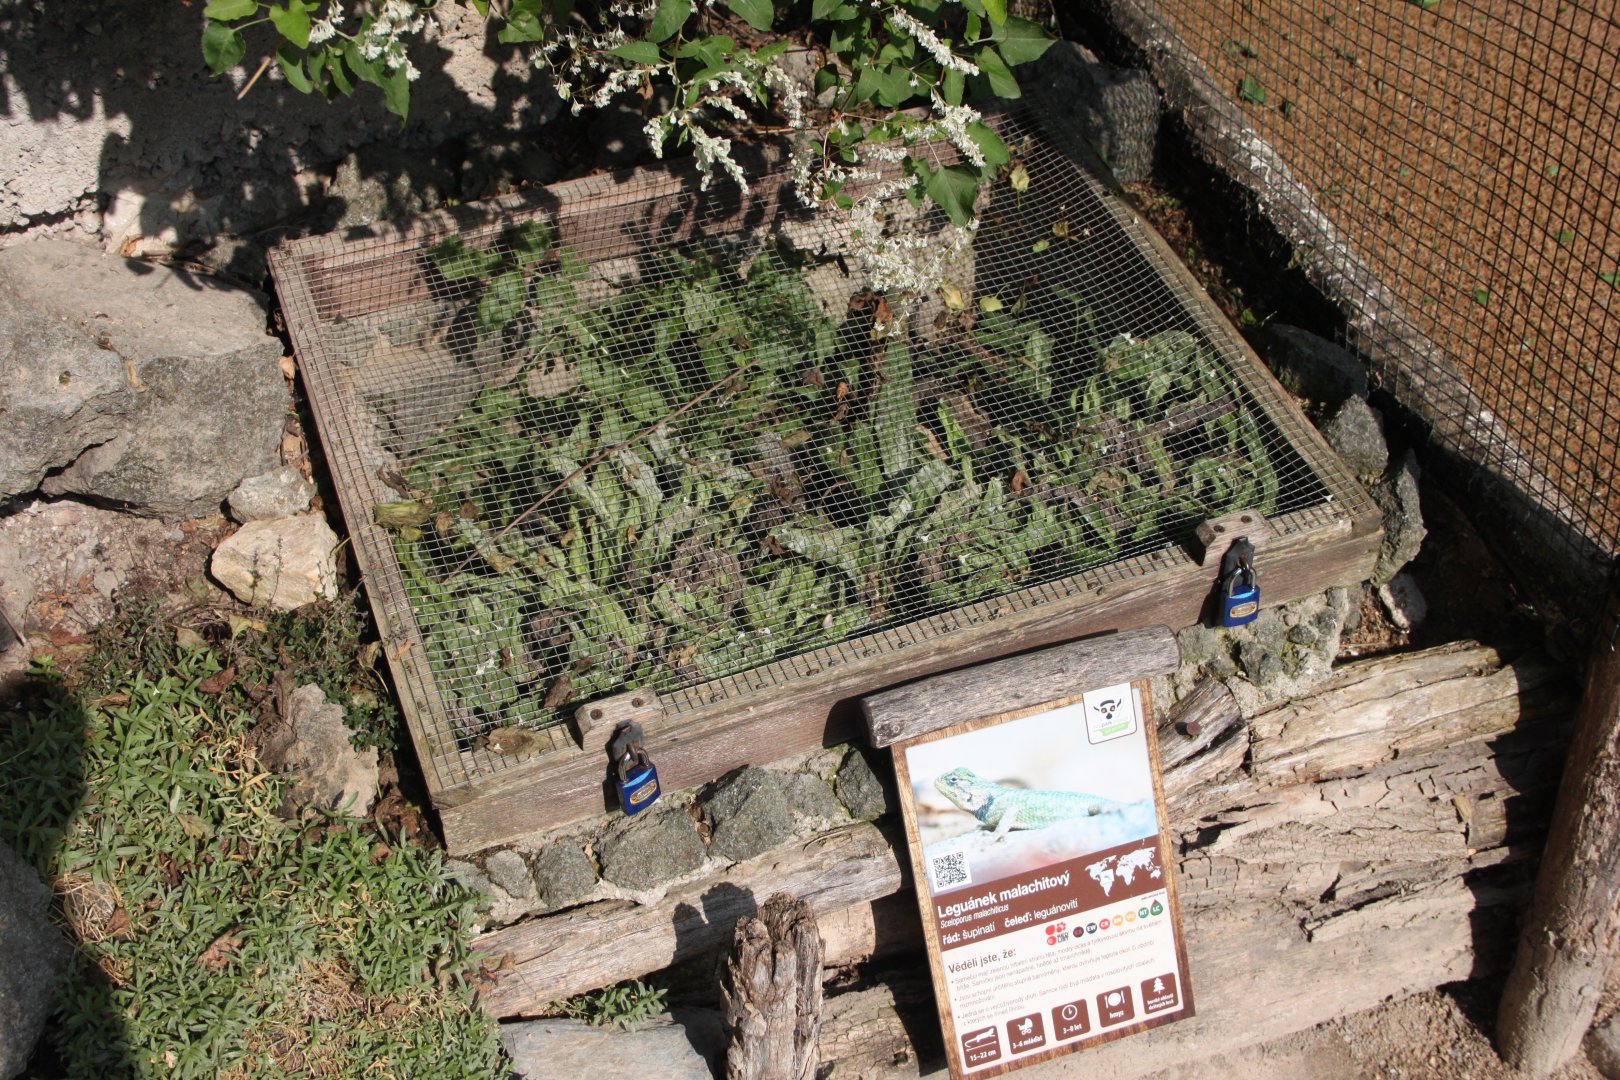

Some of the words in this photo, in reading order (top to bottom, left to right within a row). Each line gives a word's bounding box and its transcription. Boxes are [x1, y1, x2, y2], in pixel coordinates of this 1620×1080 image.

[937, 891, 998, 919] Leguánek
[1000, 871, 1069, 901] malachitový
[940, 913, 972, 930] Sceloporus
[973, 902, 1009, 920] malachiticus
[942, 931, 961, 945] řád:
[962, 922, 995, 939] šupinatí
[1004, 911, 1033, 928] čeleď:
[1034, 898, 1078, 919] leguánovití
[948, 958, 978, 973] Věděli
[980, 954, 1000, 967] jste,
[1003, 949, 1016, 959] že:
[1109, 1009, 1124, 1020] hmyz
[1074, 1023, 1083, 1031] let
[1023, 1034, 1043, 1046] mláďat
